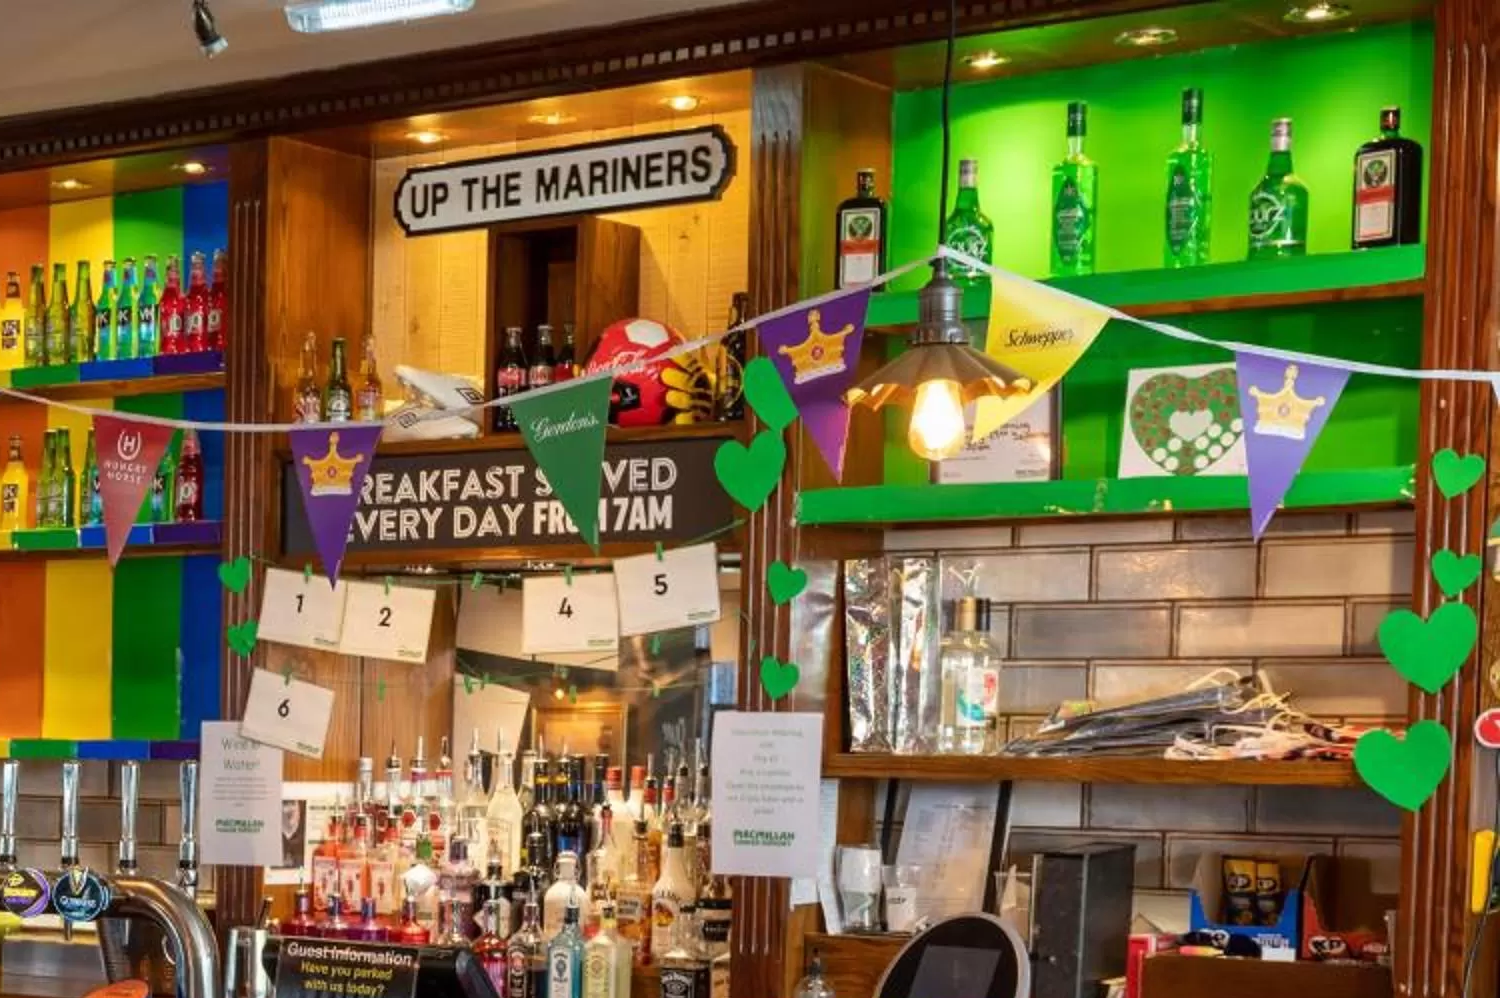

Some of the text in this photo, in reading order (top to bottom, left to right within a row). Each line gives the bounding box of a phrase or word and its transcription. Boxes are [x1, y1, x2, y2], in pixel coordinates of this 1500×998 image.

[410, 145, 713, 219] UP THE MARINERS
[358, 457, 678, 505] REAKFAST SVED
[348, 506, 444, 543] VERY
[453, 502, 526, 539] DAY
[613, 494, 673, 532] 7AM
[653, 573, 669, 597] 5
[295, 593, 305, 613] 1
[557, 597, 575, 620] 4
[379, 606, 393, 628] 2
[277, 697, 290, 718] 6
[301, 961, 330, 975] Have
[331, 966, 352, 978] you
[304, 979, 327, 990] with
[329, 983, 344, 993] us
